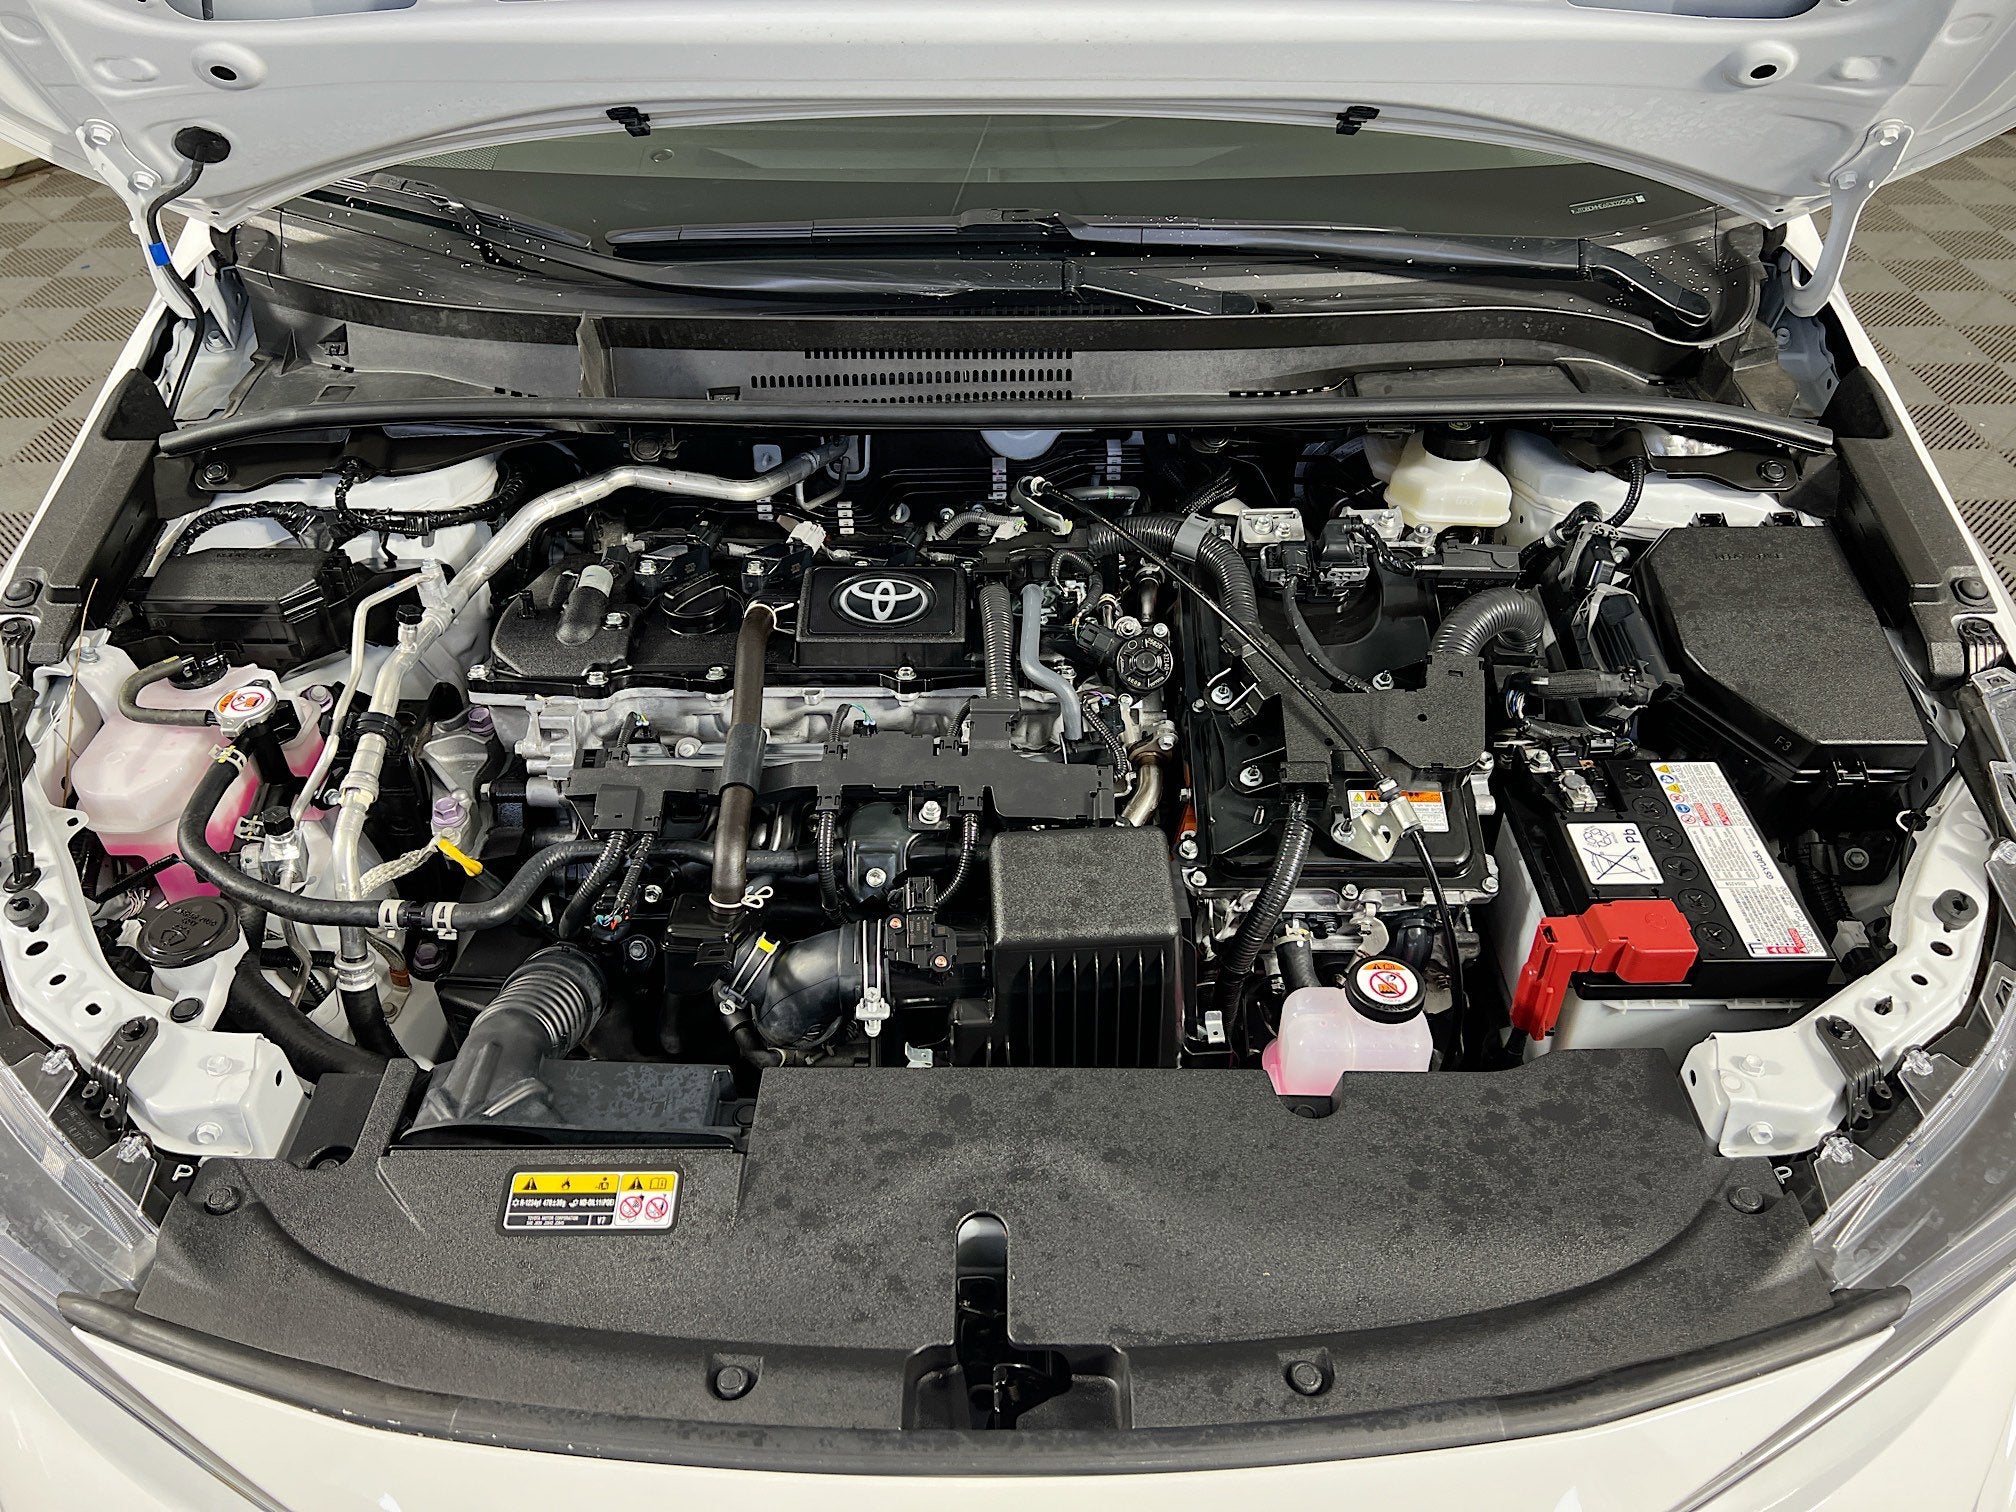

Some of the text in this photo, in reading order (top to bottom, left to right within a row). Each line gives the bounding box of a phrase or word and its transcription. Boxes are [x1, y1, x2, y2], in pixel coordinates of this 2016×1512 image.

[1775, 735, 1792, 751] F3
[1623, 828, 1640, 844] Pb
[1752, 850, 1768, 871] YUASA
[1764, 871, 1774, 879] GS
[171, 1164, 194, 1181] P
